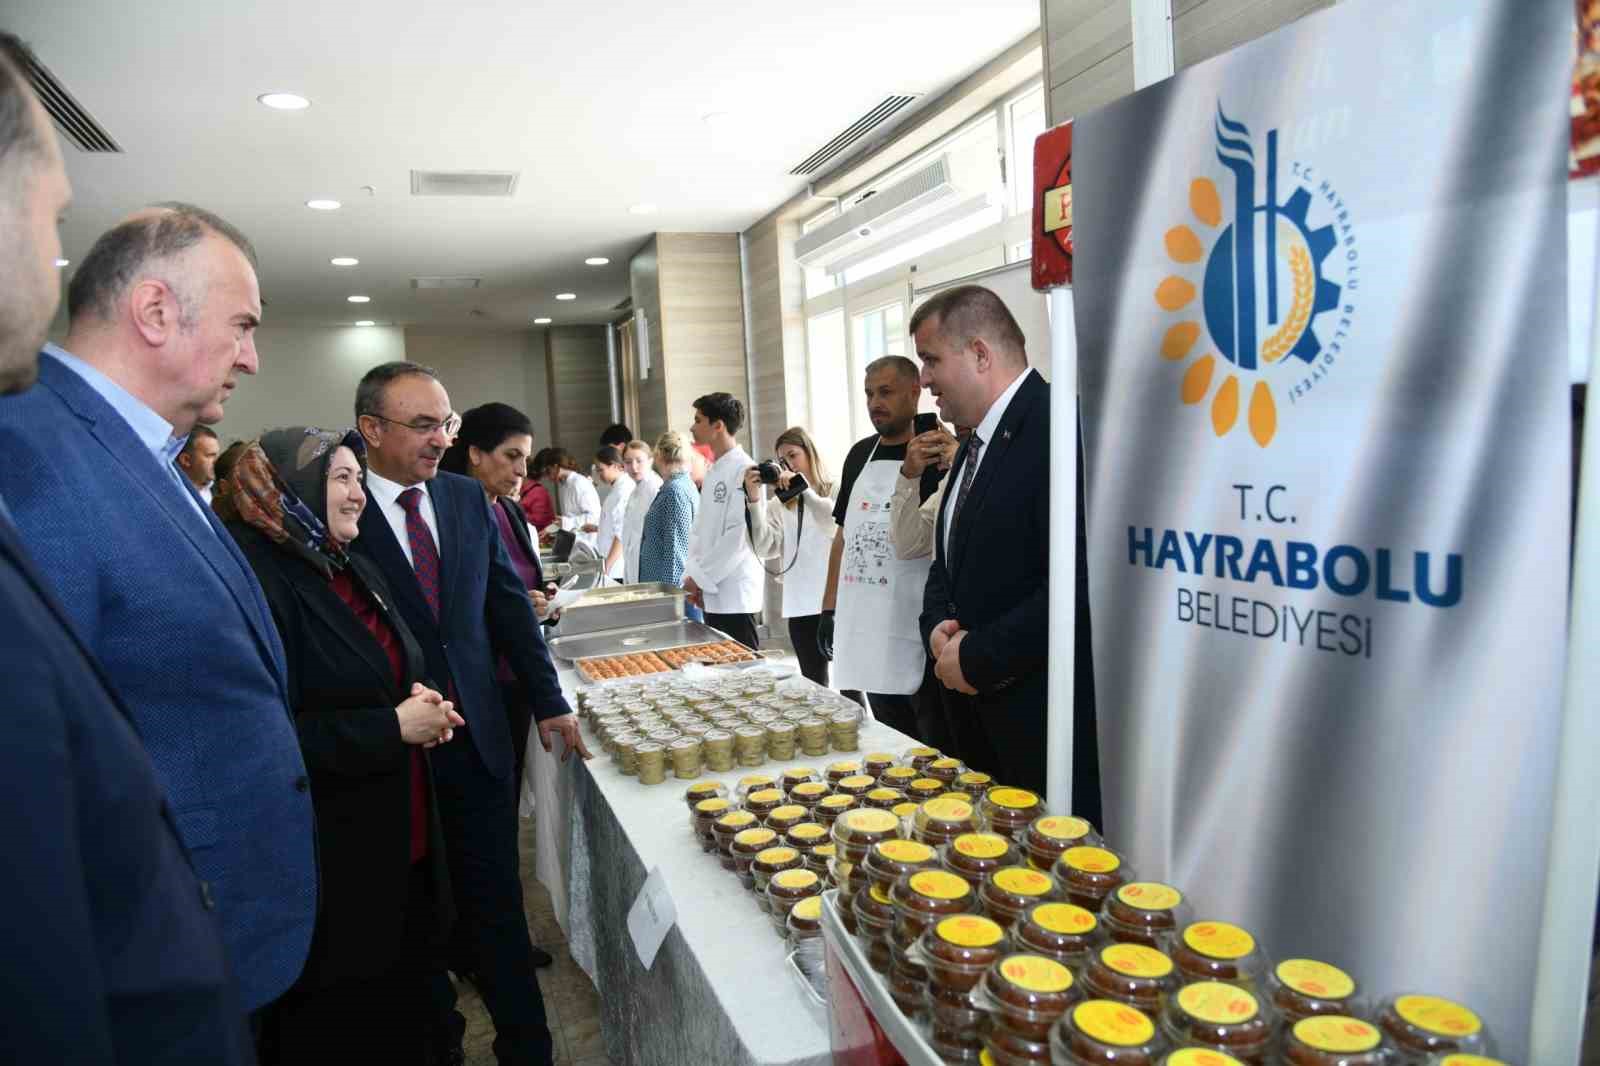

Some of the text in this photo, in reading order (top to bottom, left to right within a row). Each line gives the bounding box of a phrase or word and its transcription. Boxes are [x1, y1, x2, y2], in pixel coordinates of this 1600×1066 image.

[1232, 484, 1297, 524] T.C.
[1127, 525, 1464, 609] HAYRABOLU
[1176, 586, 1373, 660] BELEDİYESİ
